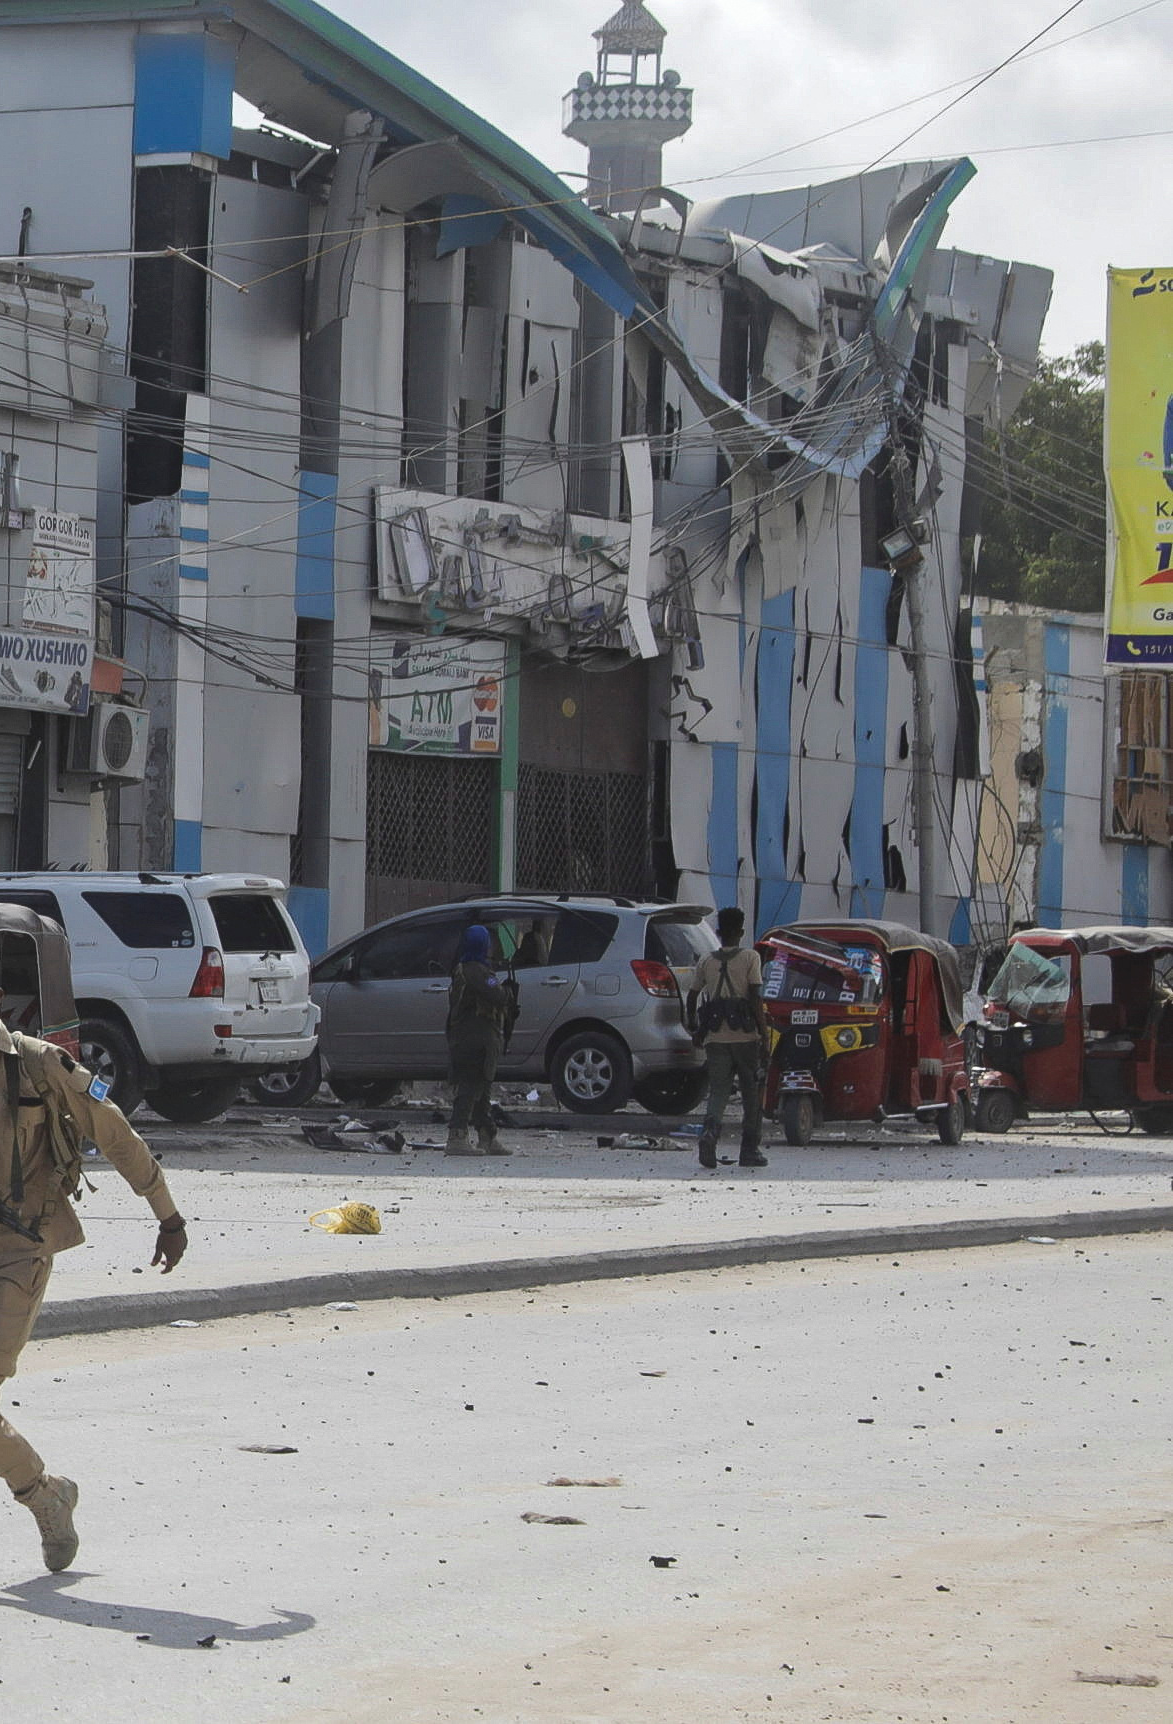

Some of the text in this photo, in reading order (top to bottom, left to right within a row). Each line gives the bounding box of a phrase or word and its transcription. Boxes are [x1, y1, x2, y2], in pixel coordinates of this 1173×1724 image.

[39, 516, 56, 532] GOR
[58, 519, 72, 535] GOR
[26, 638, 87, 667] XUSHMO
[411, 690, 453, 725] ATM
[478, 725, 494, 739] VISA
